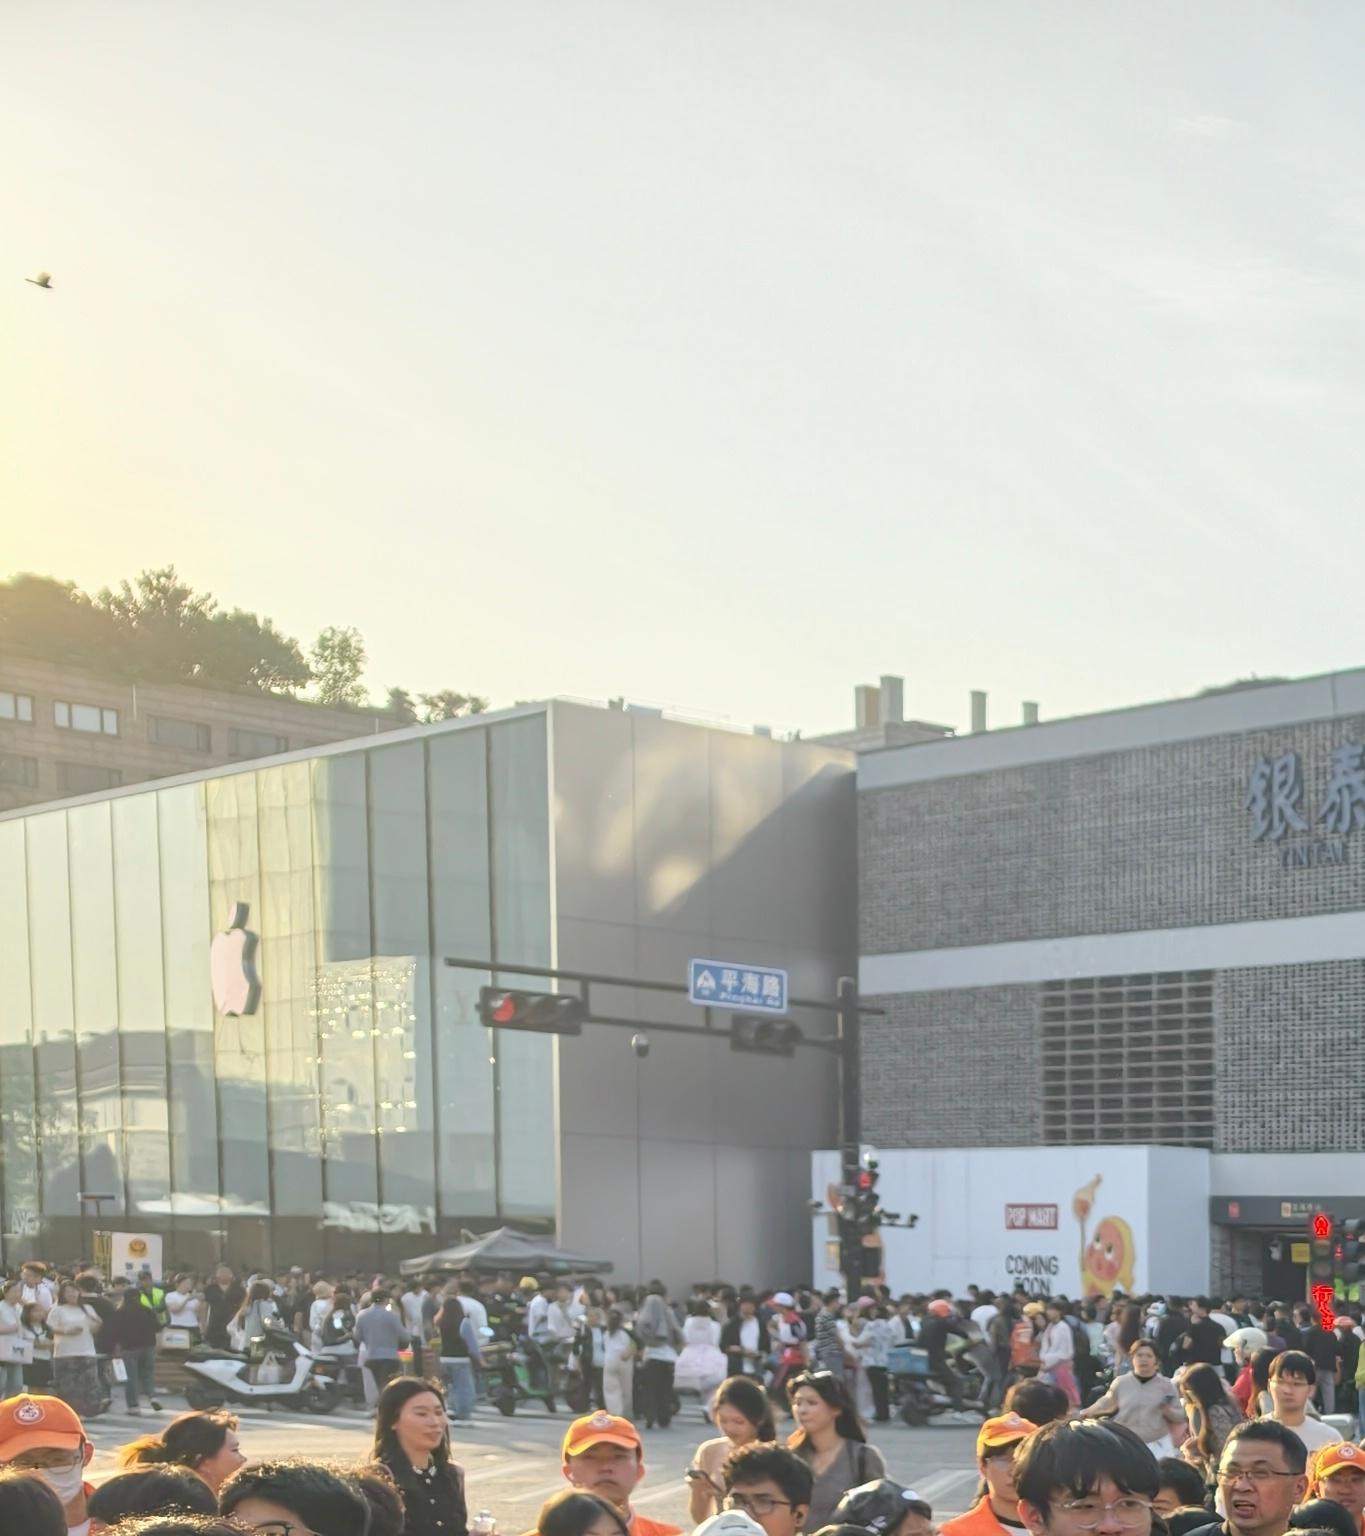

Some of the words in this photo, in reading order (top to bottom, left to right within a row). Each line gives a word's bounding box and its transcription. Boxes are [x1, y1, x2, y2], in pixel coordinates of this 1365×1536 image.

[721, 969, 781, 998] 平海路
[1007, 1207, 1026, 1228] POP
[1027, 1207, 1056, 1228] MART
[1006, 1254, 1059, 1276] COMING
